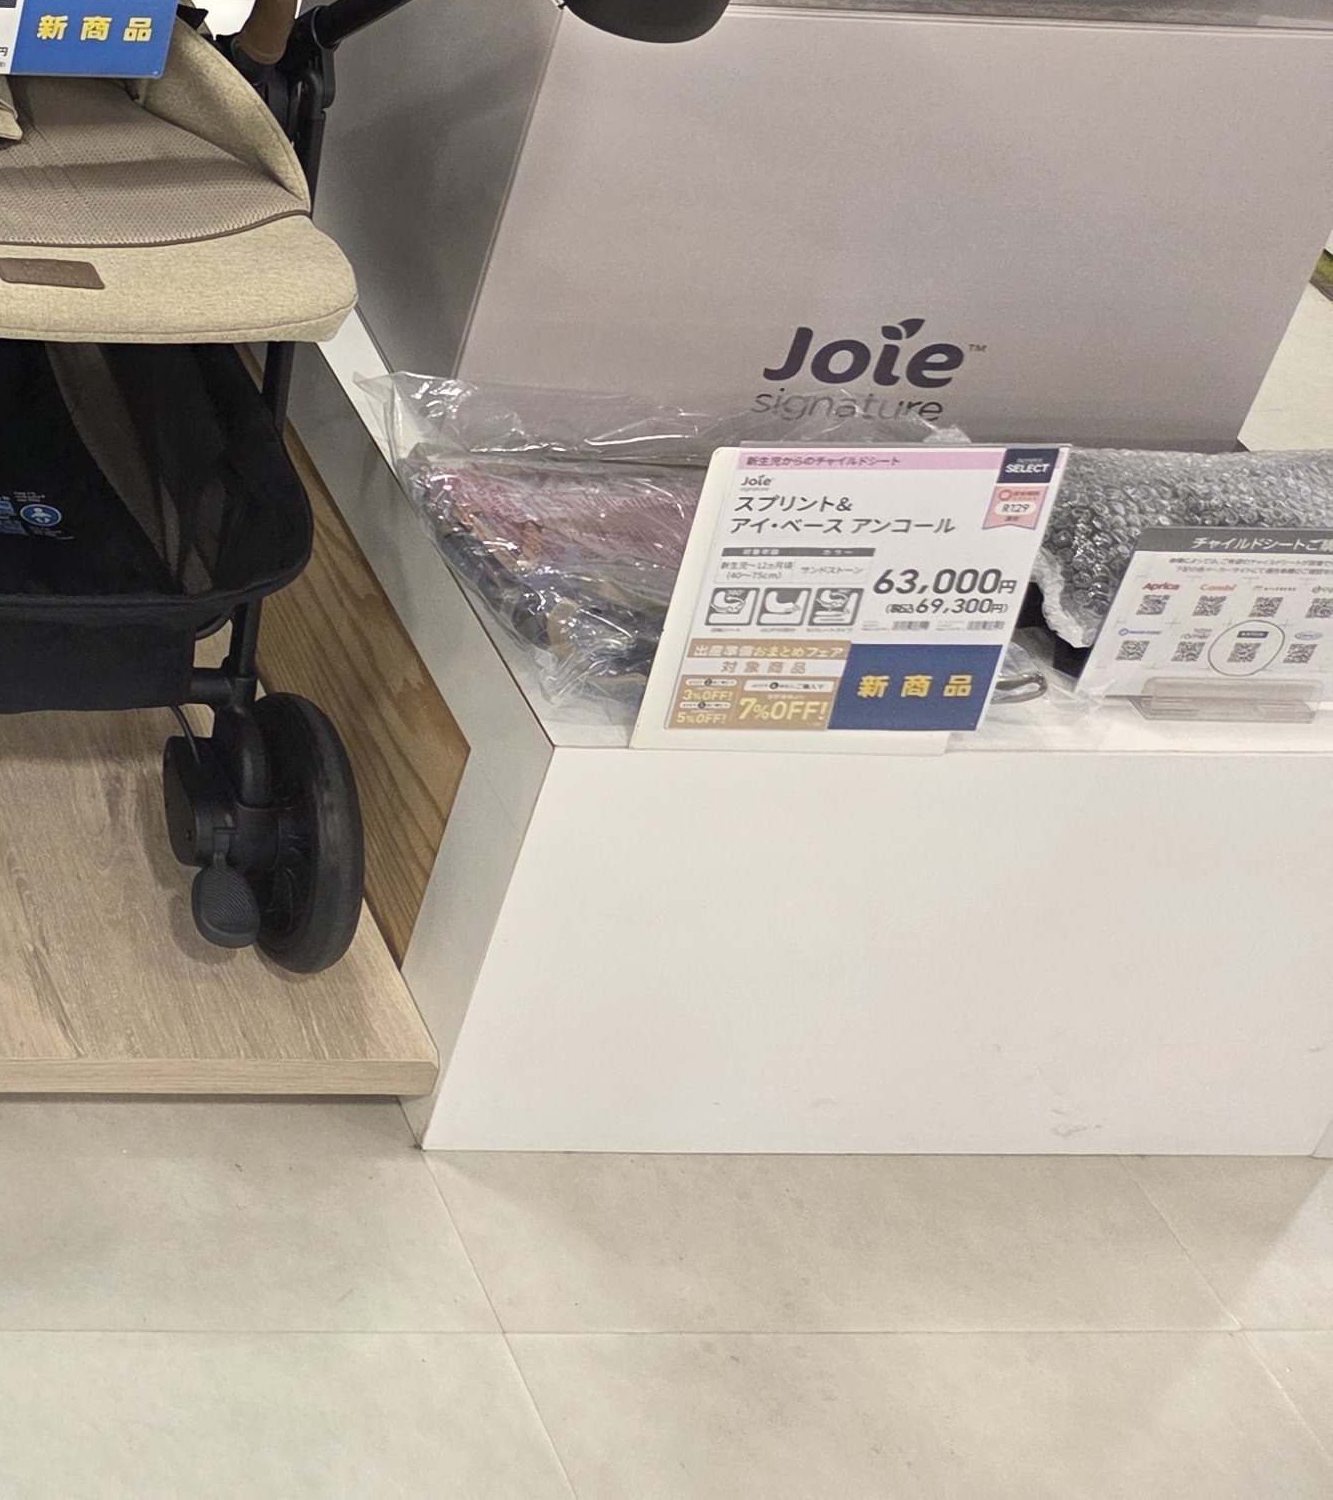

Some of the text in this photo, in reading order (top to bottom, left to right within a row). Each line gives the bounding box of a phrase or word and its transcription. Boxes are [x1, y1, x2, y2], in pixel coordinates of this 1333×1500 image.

[36, 14, 153, 42] 新商品
[763, 318, 964, 388] Joie
[749, 387, 944, 421] signature
[741, 474, 772, 487] Joie
[1005, 463, 1051, 474] SELECT
[734, 494, 853, 513] スプリント&
[730, 517, 956, 534] アイ・ベース アンコール
[873, 568, 1018, 595] 63,000円
[1142, 582, 1180, 591] Aprica
[1199, 584, 1238, 592] Combi
[857, 673, 974, 699] 新商品
[738, 697, 830, 721] 7%OFF!
